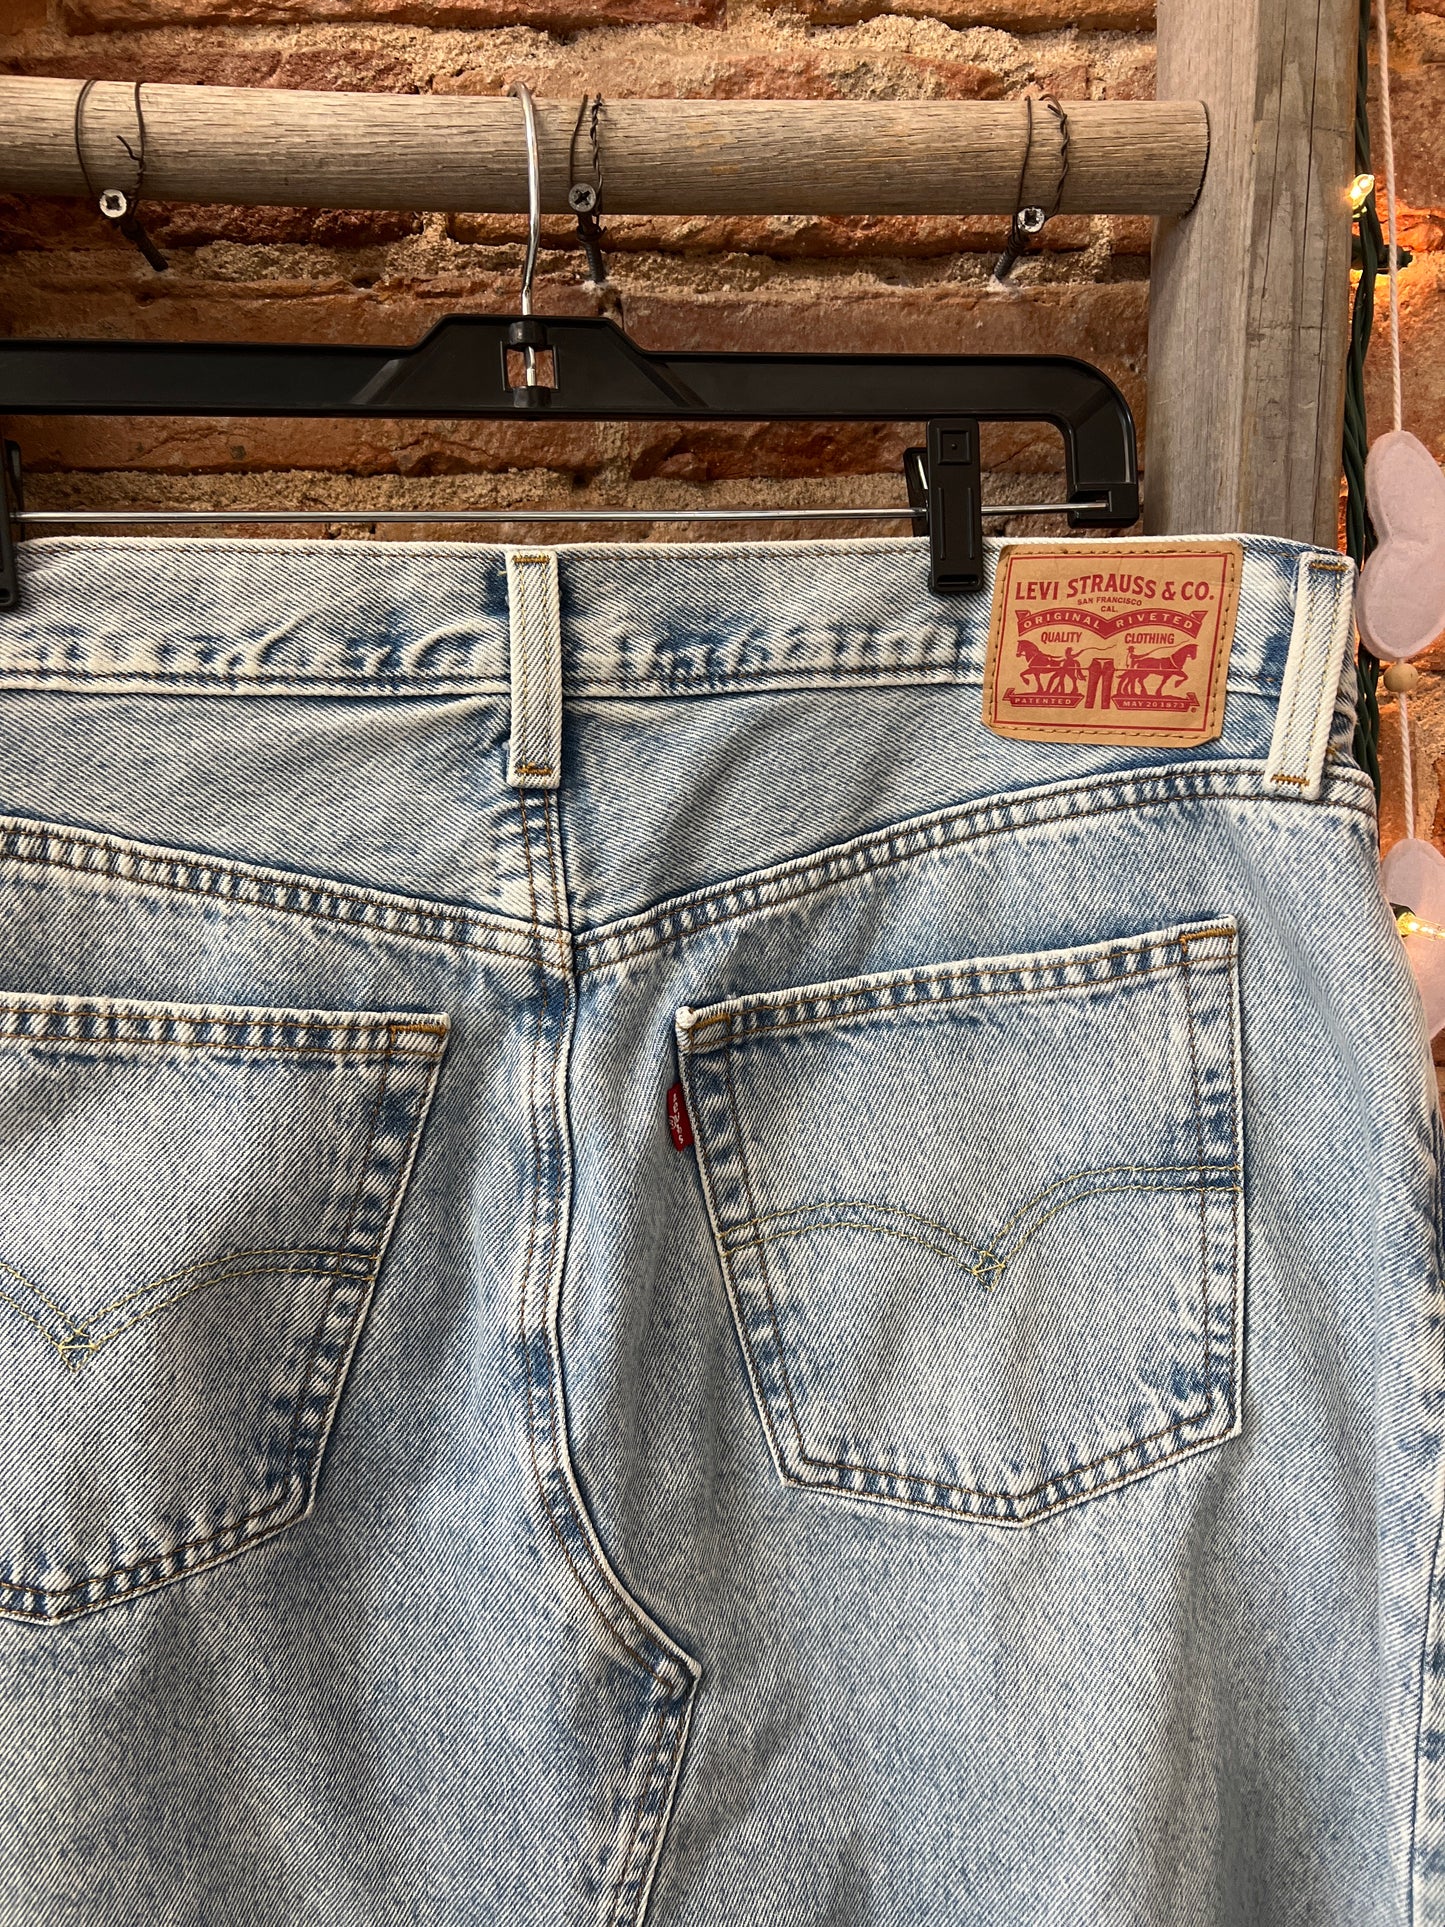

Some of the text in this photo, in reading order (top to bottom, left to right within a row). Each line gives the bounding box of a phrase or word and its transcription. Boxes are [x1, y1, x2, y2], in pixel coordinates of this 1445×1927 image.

[1015, 573, 1214, 600] LEVI STRAUSS & CO.
[1077, 596, 1142, 607] SAN FRANCISCO
[1100, 605, 1118, 613] CAL.
[1023, 612, 1193, 629] ORIGINAL RIVETED
[1040, 631, 1175, 645] QUALITY CLOTHING
[1014, 697, 1072, 705] PATENTED
[1122, 700, 1144, 708] MAY
